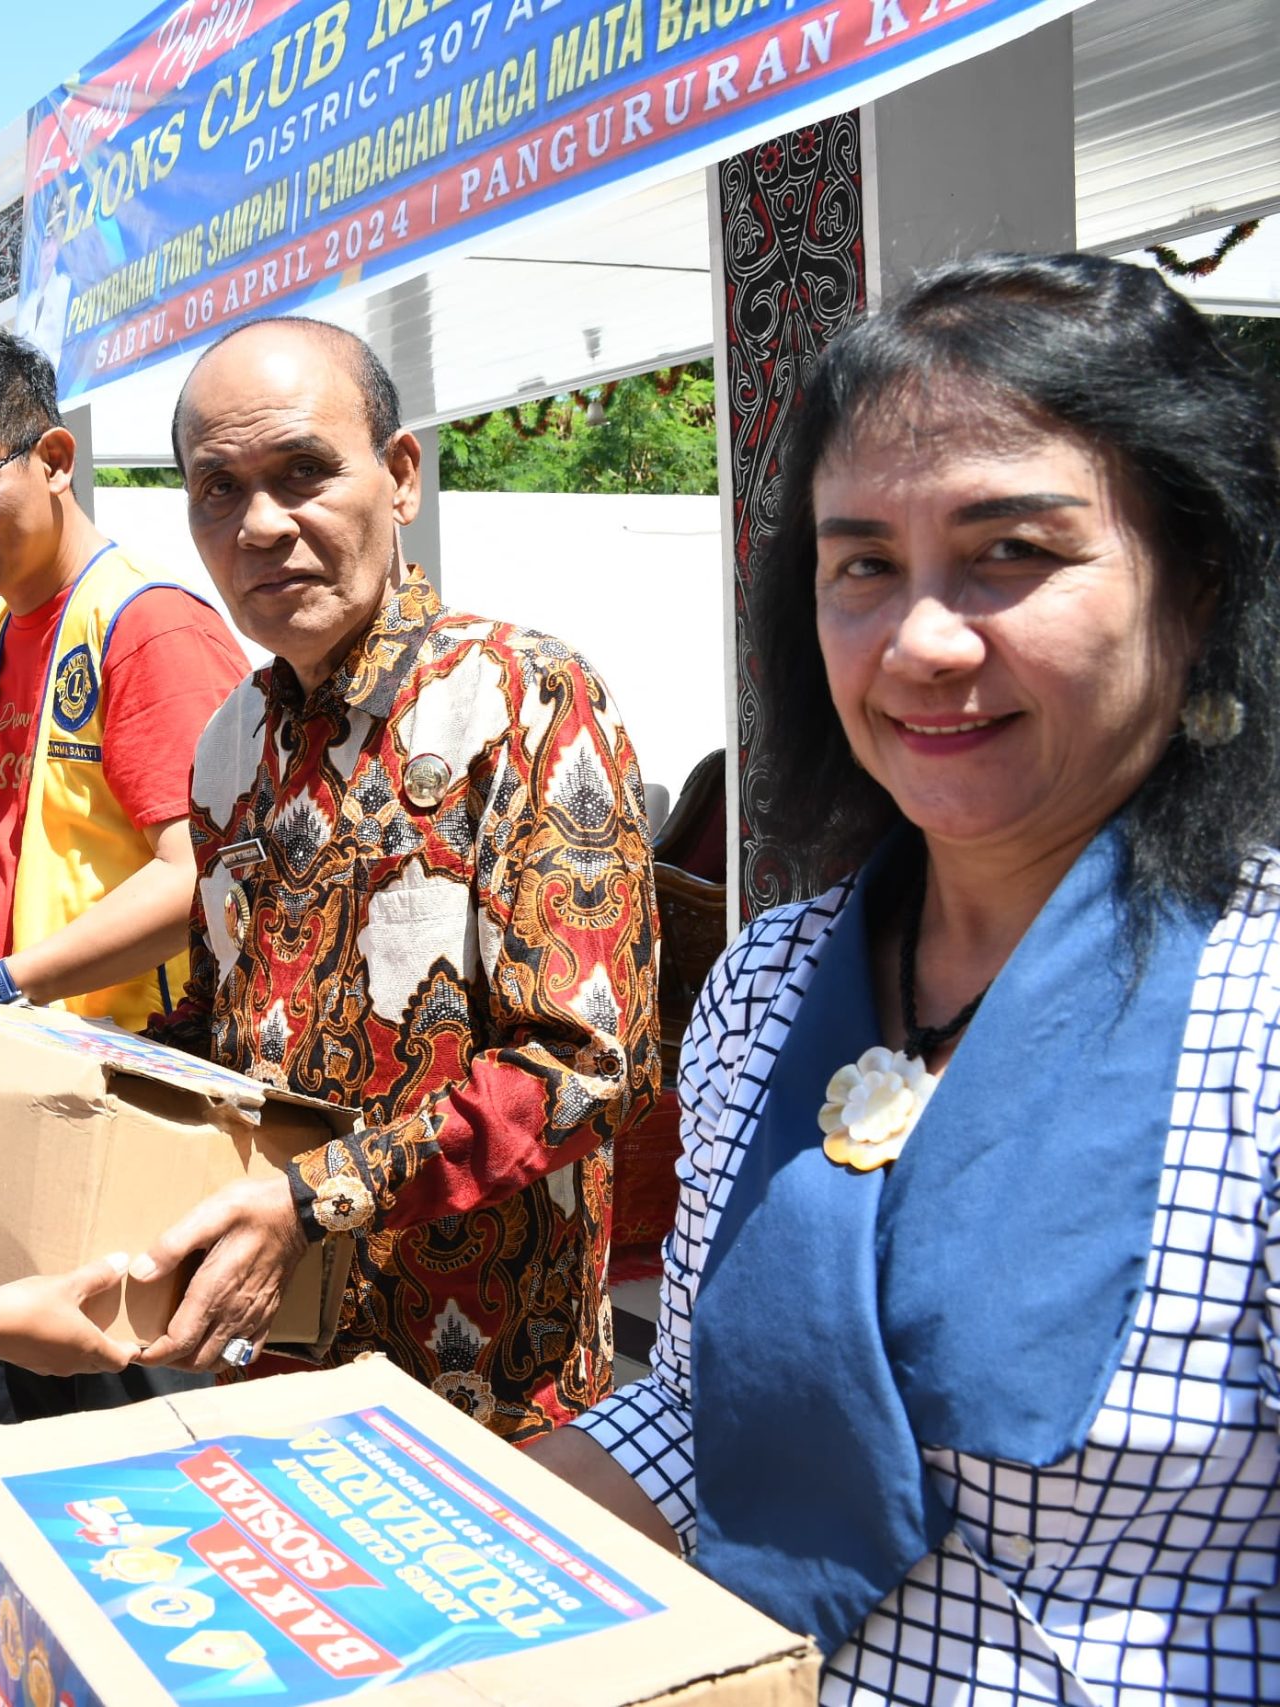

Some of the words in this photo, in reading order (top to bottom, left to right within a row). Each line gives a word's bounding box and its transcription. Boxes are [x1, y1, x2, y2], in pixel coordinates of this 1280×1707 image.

[62, 110, 186, 245] LIONS
[198, 0, 351, 150] CLUB
[244, 52, 406, 175] DISTRICT
[415, 2, 493, 79] 307
[65, 251, 158, 338] PENYERAHAN
[161, 224, 205, 290] TONG
[207, 177, 288, 264] SAMPAH
[305, 93, 452, 218] PEMBAGIAN
[456, 49, 537, 144] KACA
[546, 0, 643, 101] MATA
[96, 311, 174, 369] SABTU,
[184, 288, 214, 330] 06
[222, 245, 312, 314] APRIL
[324, 201, 409, 270] 2024
[457, 11, 841, 213] PANGURURAN
[272, 1458, 354, 1518] MEDAN
[345, 1431, 436, 1500] INDONESIA
[428, 1499, 460, 1520] A2
[199, 1461, 348, 1579] SOSIAL
[288, 1429, 565, 1640] TRIDHARMA
[340, 1517, 405, 1565] CLUB
[451, 1518, 493, 1545] 307
[206, 1545, 380, 1671] BAKTI
[394, 1561, 481, 1623] LIONS
[488, 1541, 582, 1612] DISTRICT
